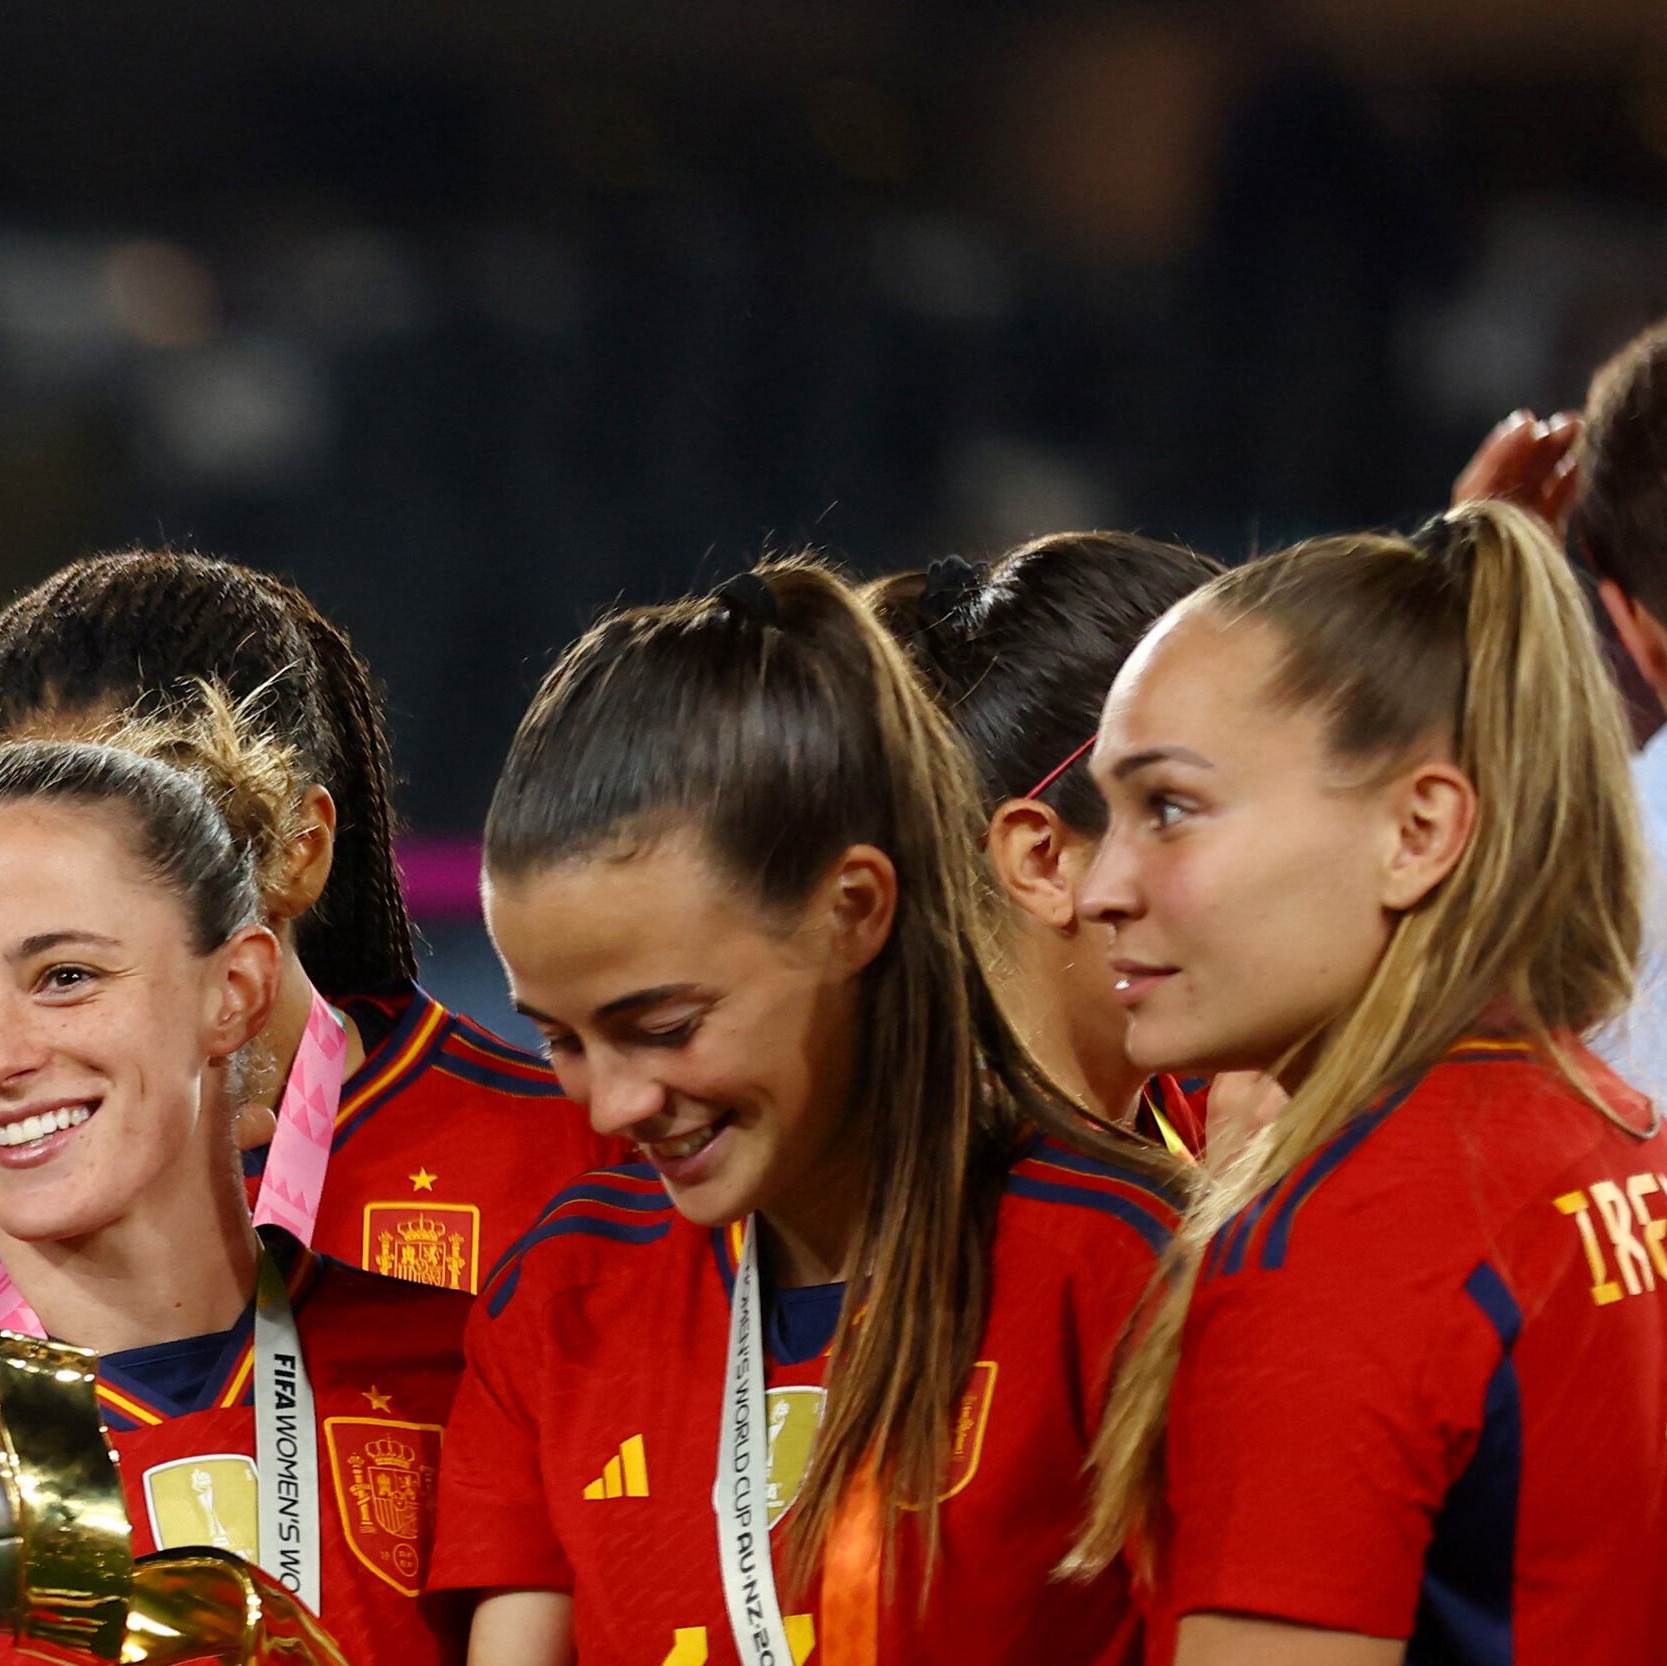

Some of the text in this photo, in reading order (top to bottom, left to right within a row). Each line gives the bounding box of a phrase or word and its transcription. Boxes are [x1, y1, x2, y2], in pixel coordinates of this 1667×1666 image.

[1552, 1172, 1667, 1306] IRE
[273, 1353, 297, 1411] FIFA
[733, 1380, 751, 1474] WORLD
[275, 1414, 301, 1544] WOMEN'S
[732, 1476, 753, 1527] CUP
